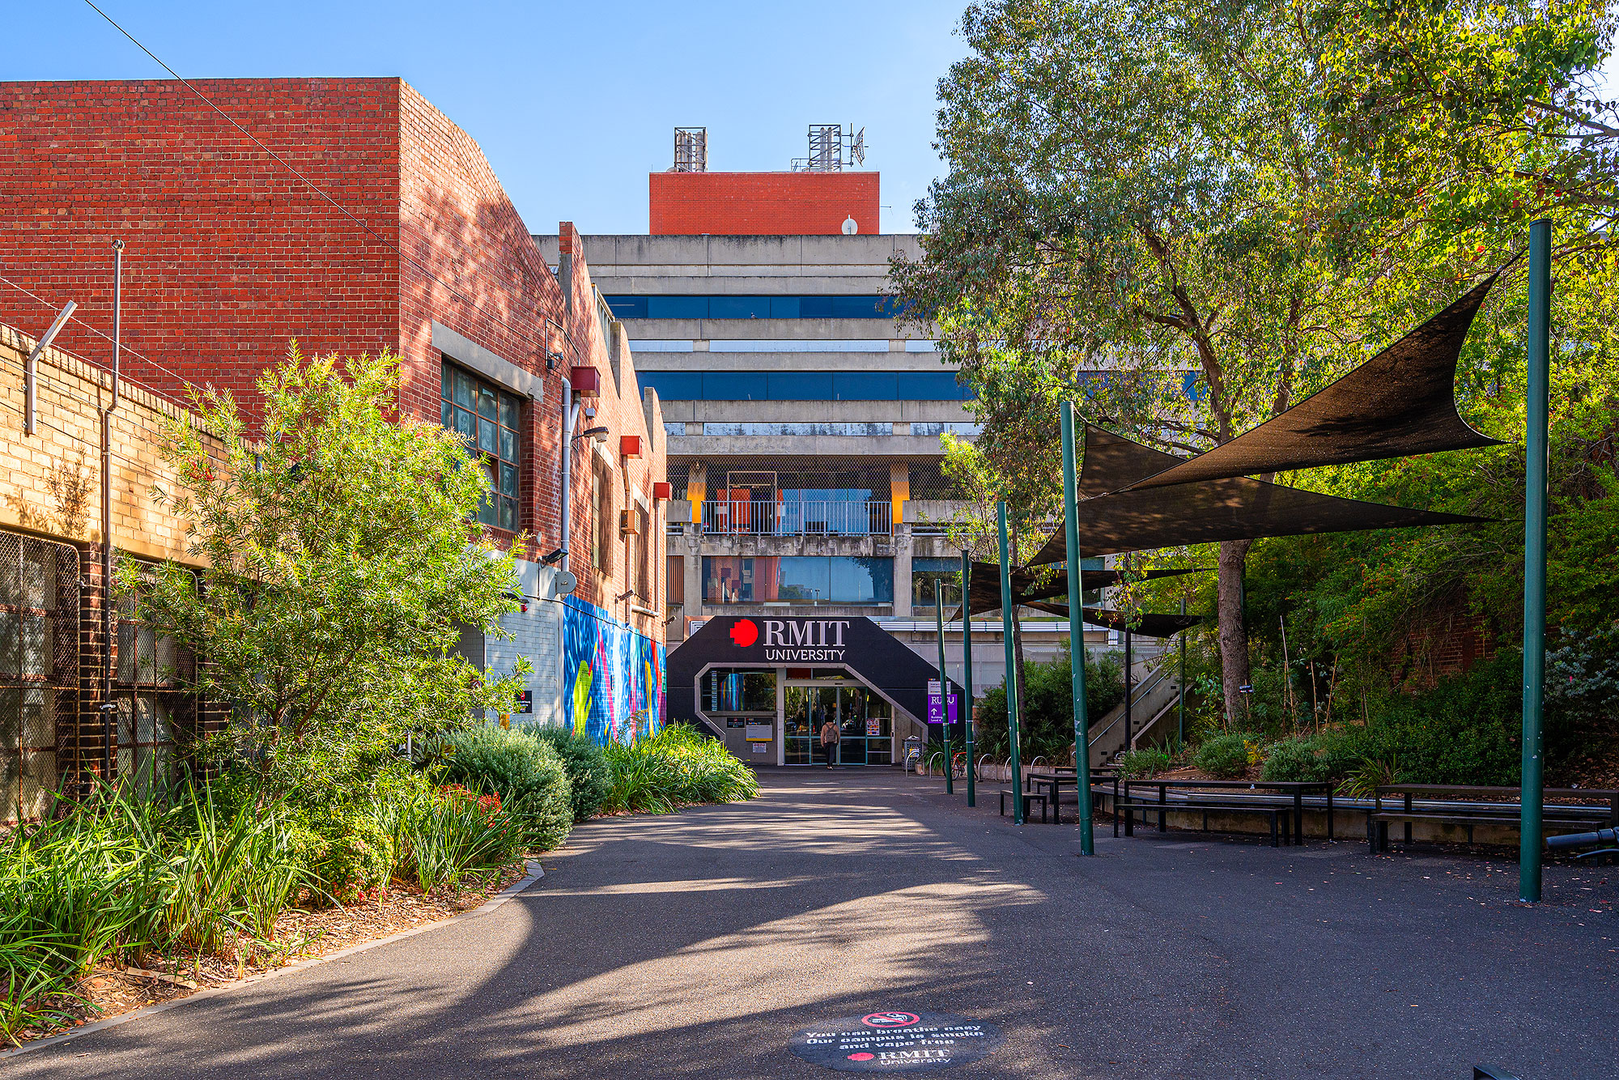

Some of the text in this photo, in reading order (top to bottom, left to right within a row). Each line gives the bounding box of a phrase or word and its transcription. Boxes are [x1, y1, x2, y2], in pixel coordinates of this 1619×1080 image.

[763, 620, 850, 647] RMIT
[765, 649, 846, 661] UNIVERSITY
[876, 1026, 939, 1035] breathe
[840, 1035, 905, 1043] campus
[931, 1030, 985, 1038] smoke
[839, 1042, 870, 1050] and
[878, 1049, 950, 1060] RMIT
[880, 1058, 952, 1066] University
